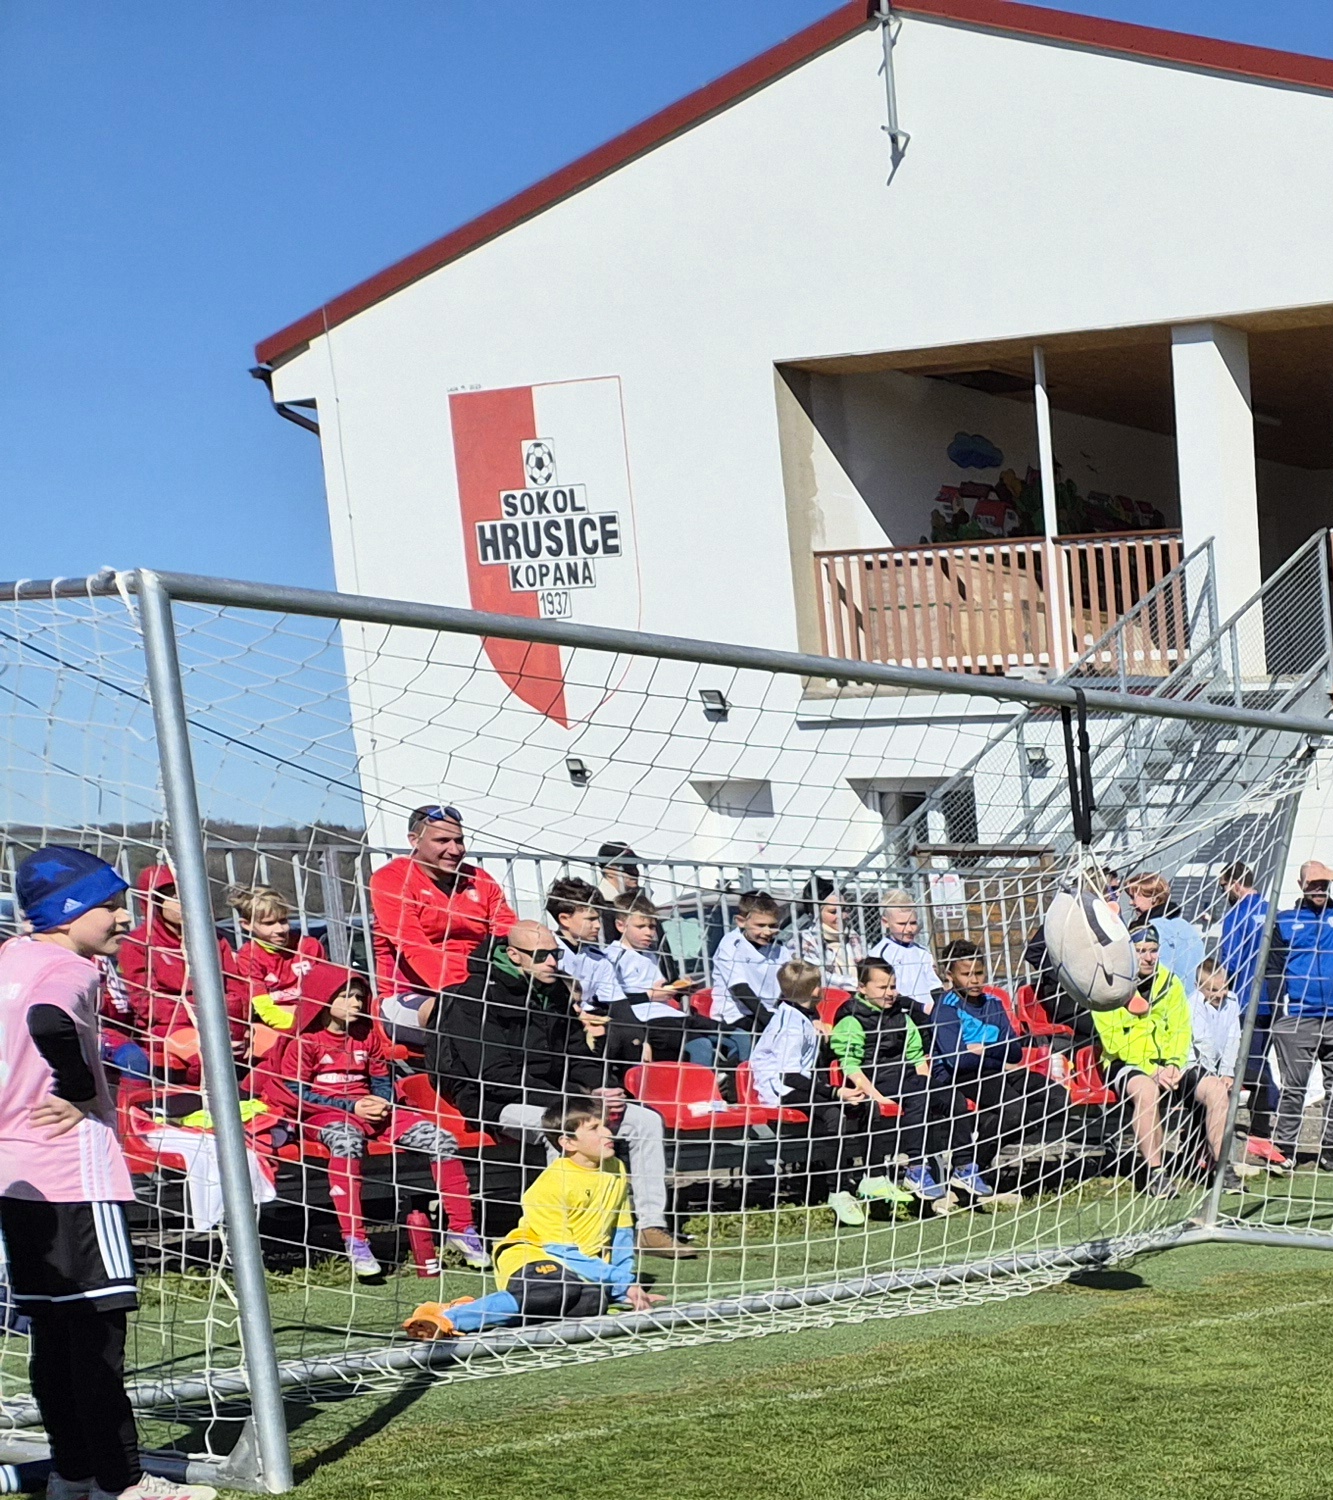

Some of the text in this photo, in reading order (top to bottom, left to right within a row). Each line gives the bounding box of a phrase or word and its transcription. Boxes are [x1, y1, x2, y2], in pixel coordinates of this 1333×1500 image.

[503, 488, 586, 517] SOKOL
[477, 515, 620, 562] HRUSICE
[511, 558, 594, 588] KOPANÁ
[540, 592, 568, 616] 1937
